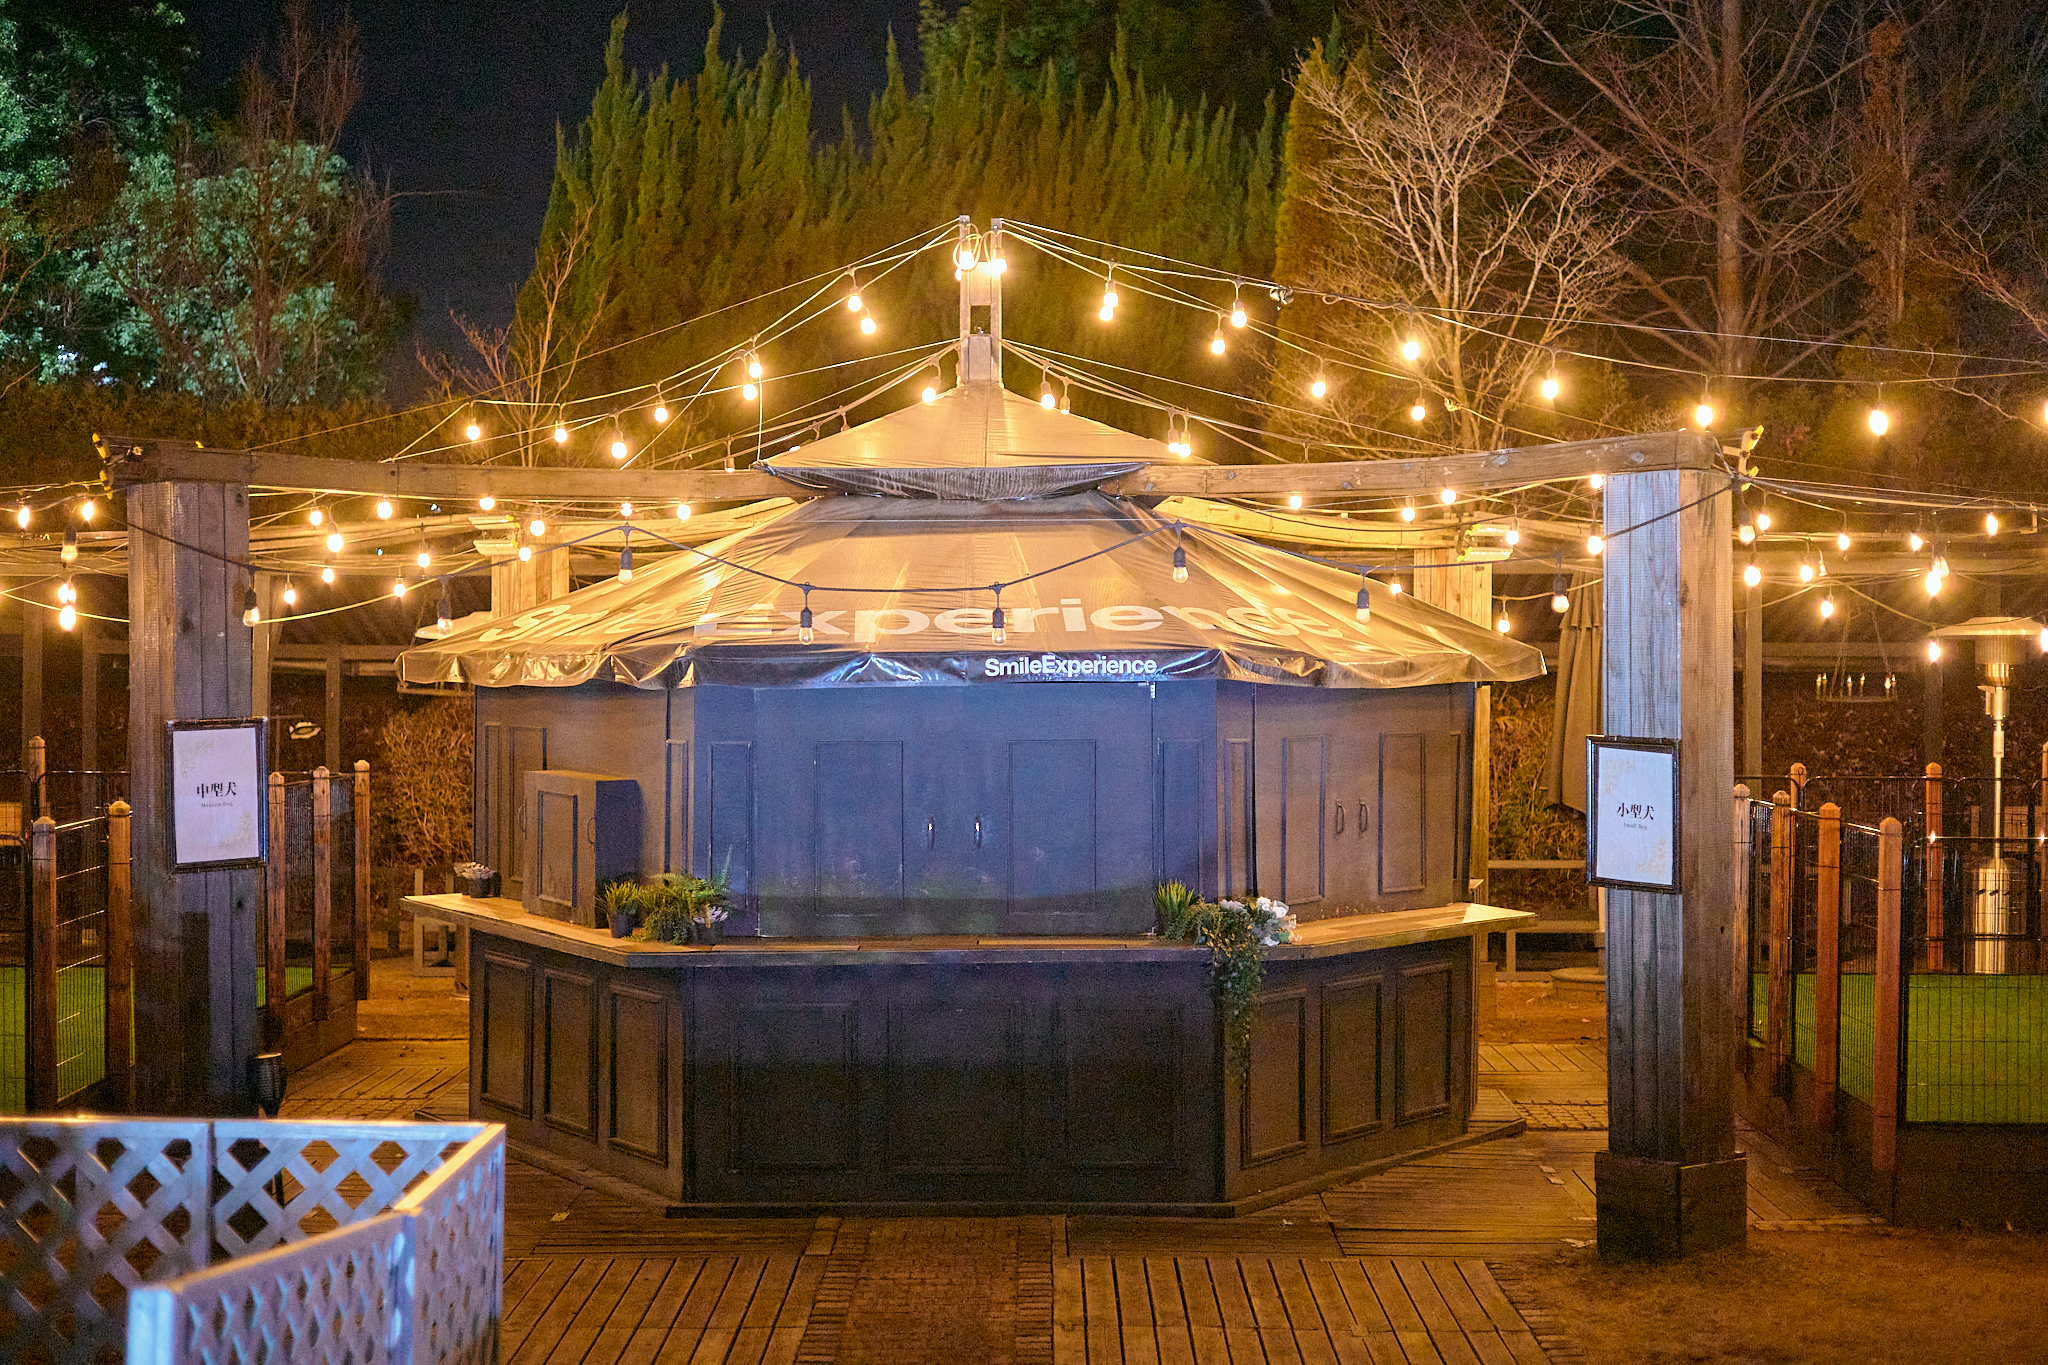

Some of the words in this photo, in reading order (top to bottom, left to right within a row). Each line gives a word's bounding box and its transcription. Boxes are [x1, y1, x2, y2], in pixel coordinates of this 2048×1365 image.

[984, 655, 1158, 677] SmileExperience
[196, 781, 237, 799] 中型犬
[1617, 802, 1655, 820] 小型犬
